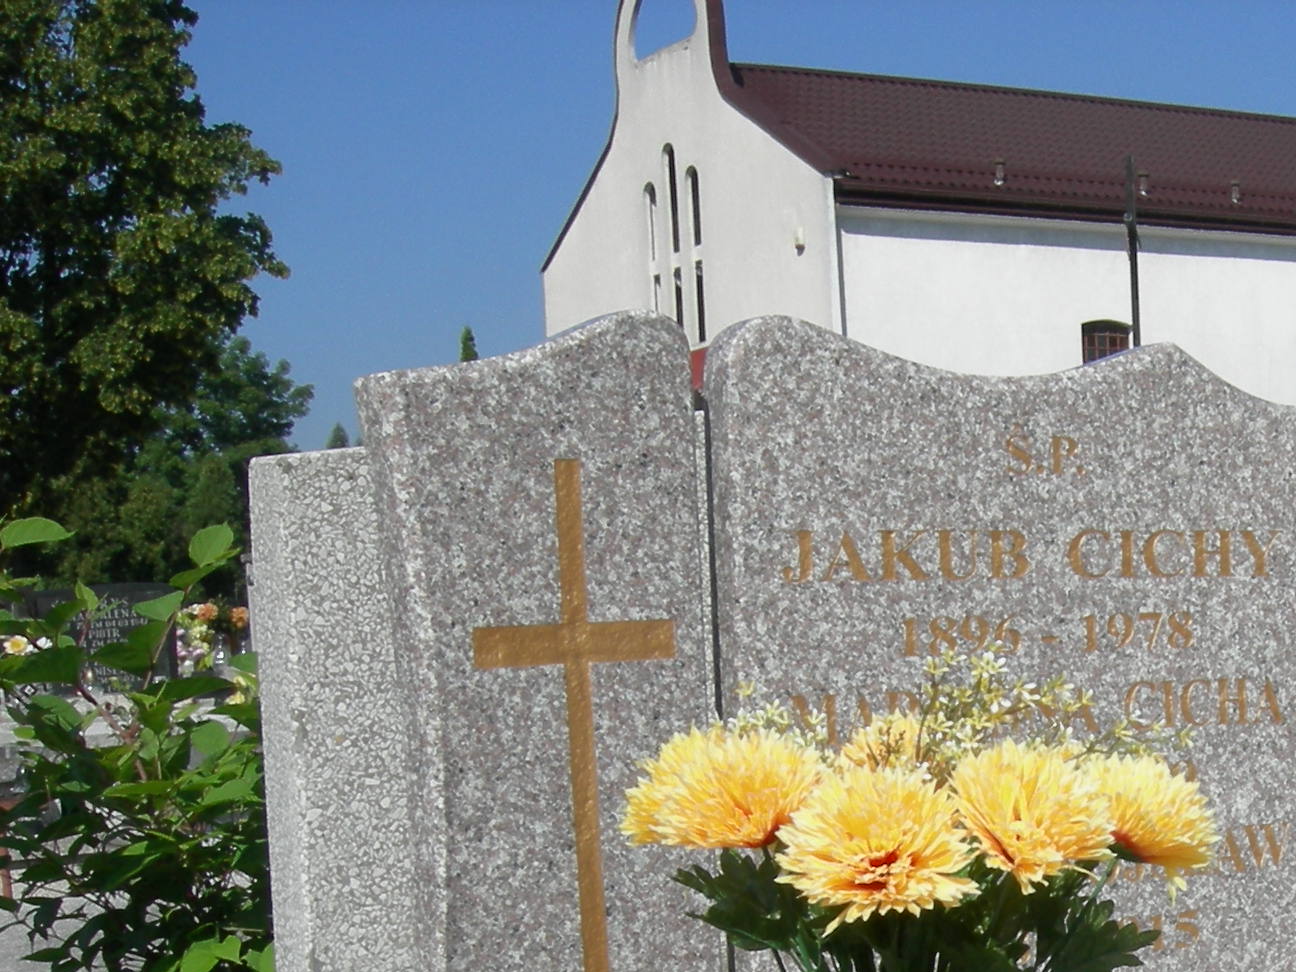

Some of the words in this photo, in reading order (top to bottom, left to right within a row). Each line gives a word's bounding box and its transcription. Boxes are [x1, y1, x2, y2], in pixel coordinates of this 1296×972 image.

[781, 529, 1033, 583] JAKUB
[1066, 528, 1283, 580] CICHY
[902, 612, 1023, 657] 1896
[1083, 611, 1194, 652] 1978
[1124, 676, 1284, 732] CICHA
